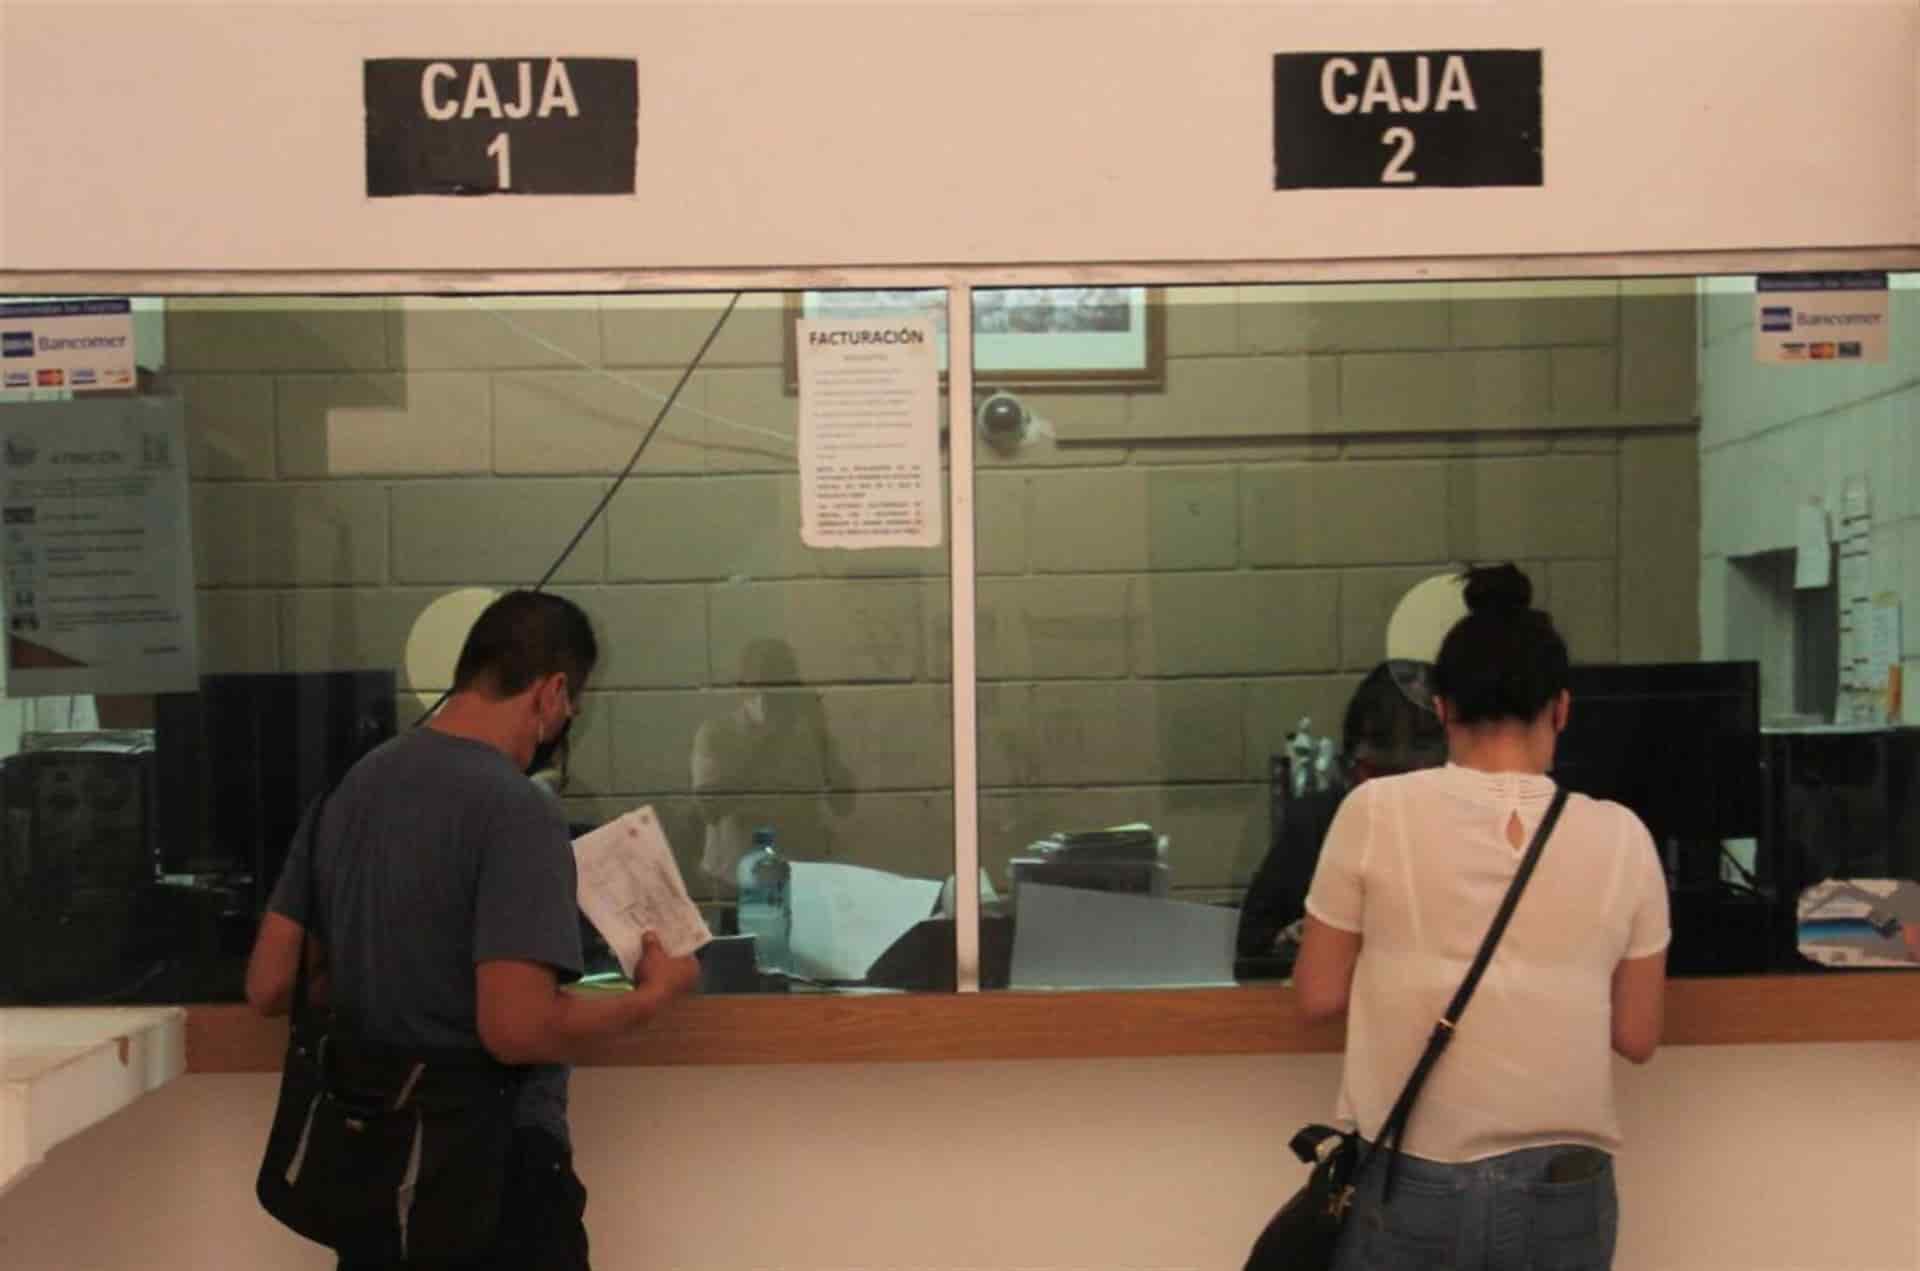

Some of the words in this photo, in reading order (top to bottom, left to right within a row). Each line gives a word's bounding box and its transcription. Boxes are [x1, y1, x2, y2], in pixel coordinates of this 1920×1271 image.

[421, 60, 580, 120] CAJA
[1321, 56, 1477, 115] CAJA
[486, 132, 511, 189] 1
[1381, 126, 1416, 183] 2
[39, 335, 127, 351] Bancomer
[809, 327, 924, 346] FACTURACIÓN
